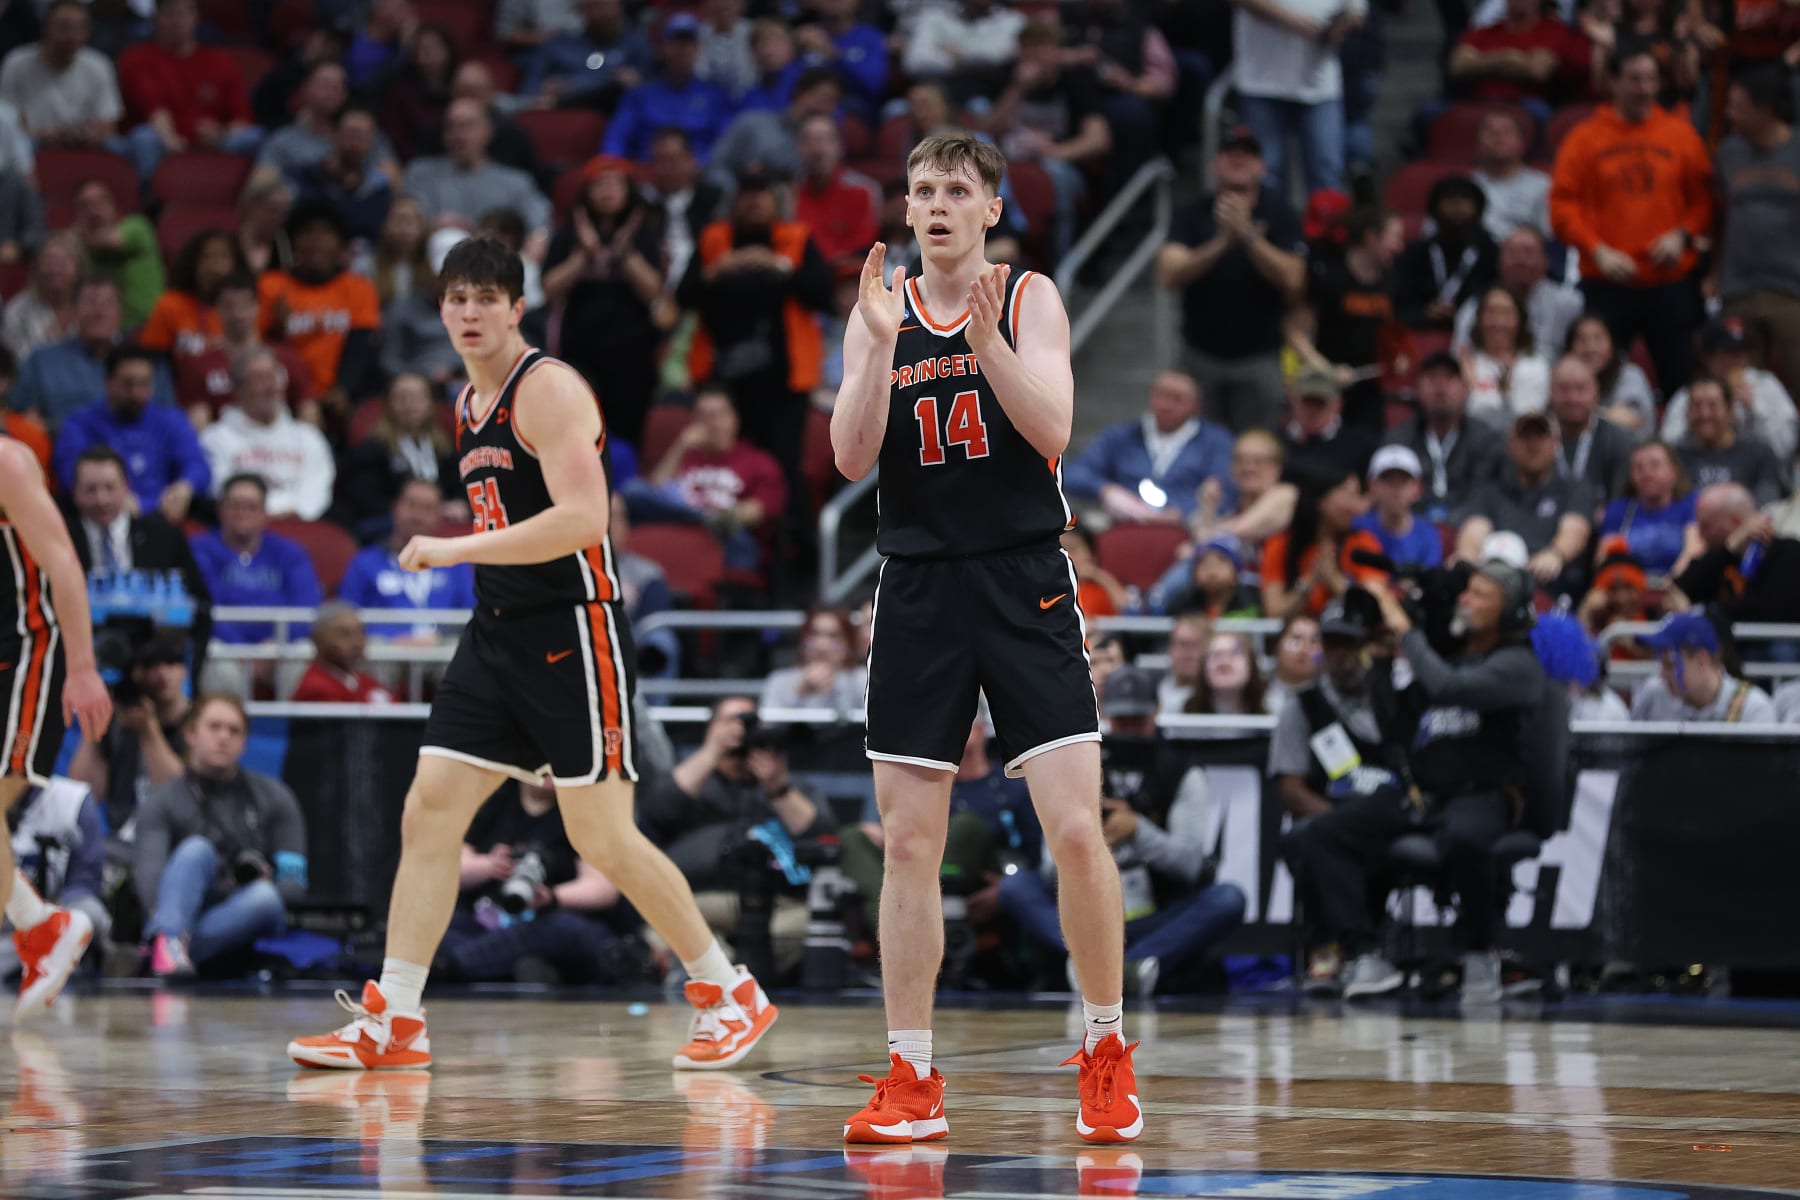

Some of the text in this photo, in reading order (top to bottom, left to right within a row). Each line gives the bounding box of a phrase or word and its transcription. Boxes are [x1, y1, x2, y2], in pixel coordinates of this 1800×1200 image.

[914, 389, 989, 466] 14
[466, 476, 510, 534] 54
[604, 727, 624, 755] P
